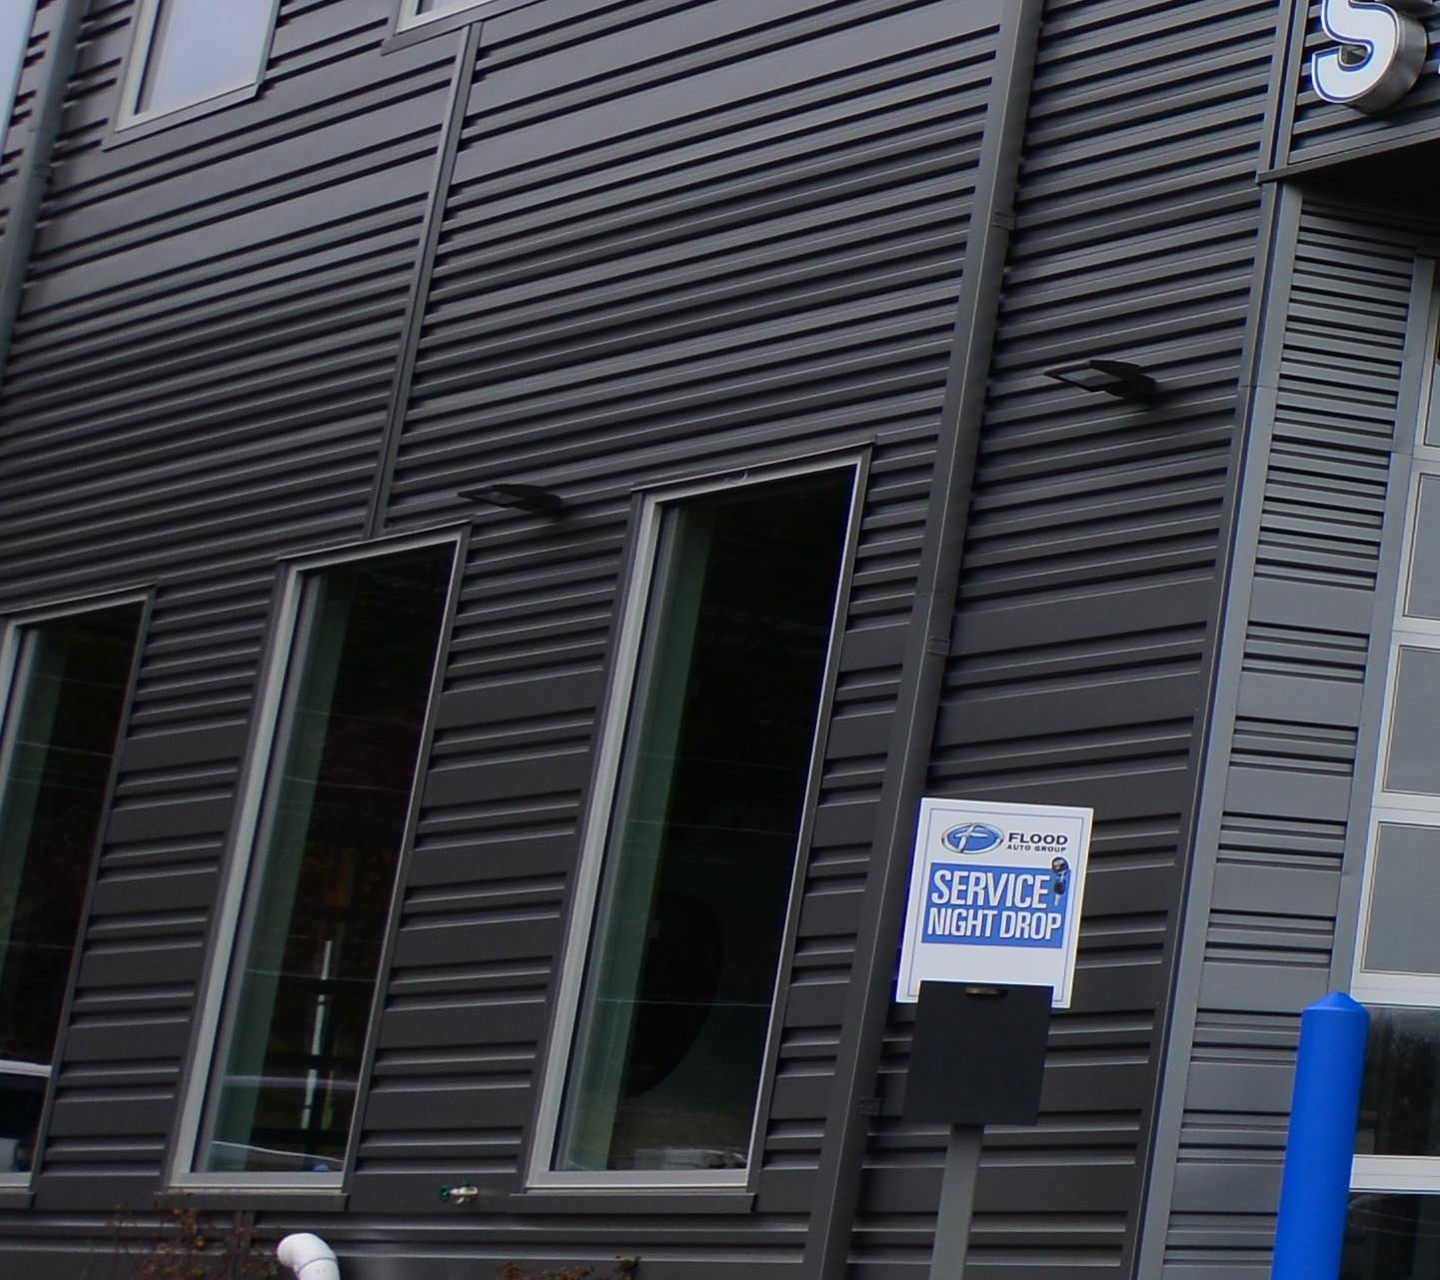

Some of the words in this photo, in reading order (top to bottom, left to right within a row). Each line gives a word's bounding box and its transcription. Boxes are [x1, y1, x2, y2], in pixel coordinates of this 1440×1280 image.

[1006, 844, 1031, 852] AUTO
[1034, 845, 1067, 853] GROUP
[1008, 832, 1068, 846] FLOOD
[931, 869, 1050, 909] SERVICE
[927, 907, 998, 937] NIGHT
[999, 910, 1062, 940] DROP
